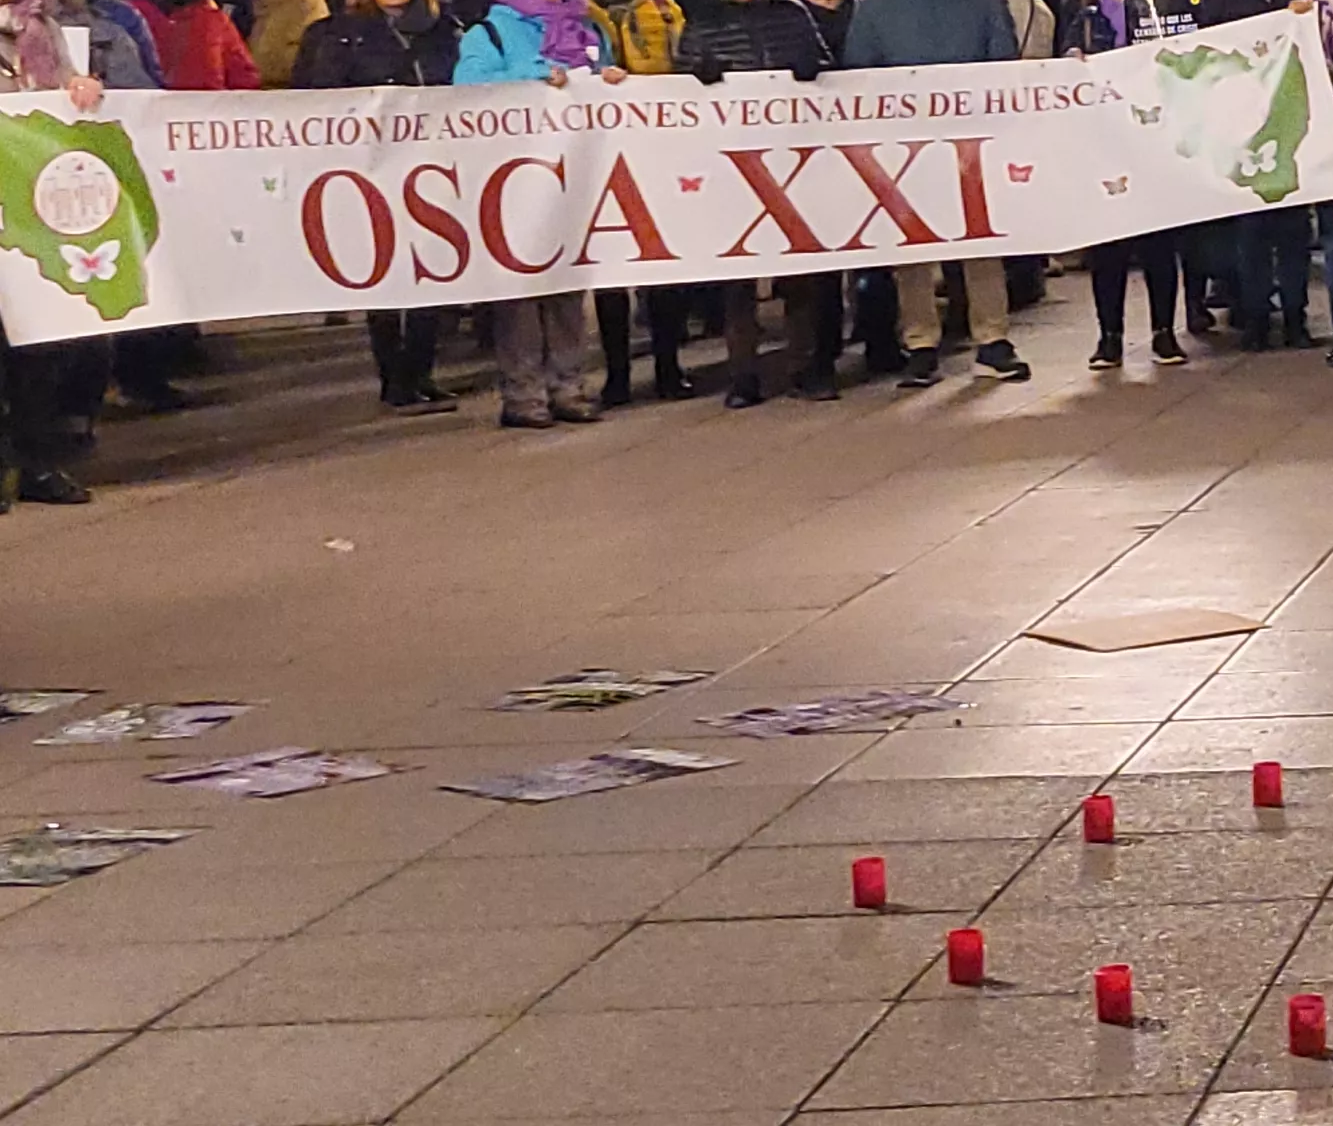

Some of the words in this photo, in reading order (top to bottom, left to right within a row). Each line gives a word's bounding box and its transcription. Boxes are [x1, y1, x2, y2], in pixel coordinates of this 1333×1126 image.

[166, 107, 383, 151] FEDERACIÓN
[391, 113, 430, 143] DE
[437, 100, 699, 140] ASOCIACIONES
[711, 93, 917, 128] VECINALES
[928, 91, 973, 118] DE
[984, 81, 1123, 114] HUESCA
[301, 152, 682, 291] OSCA
[716, 136, 1009, 259] XXI
